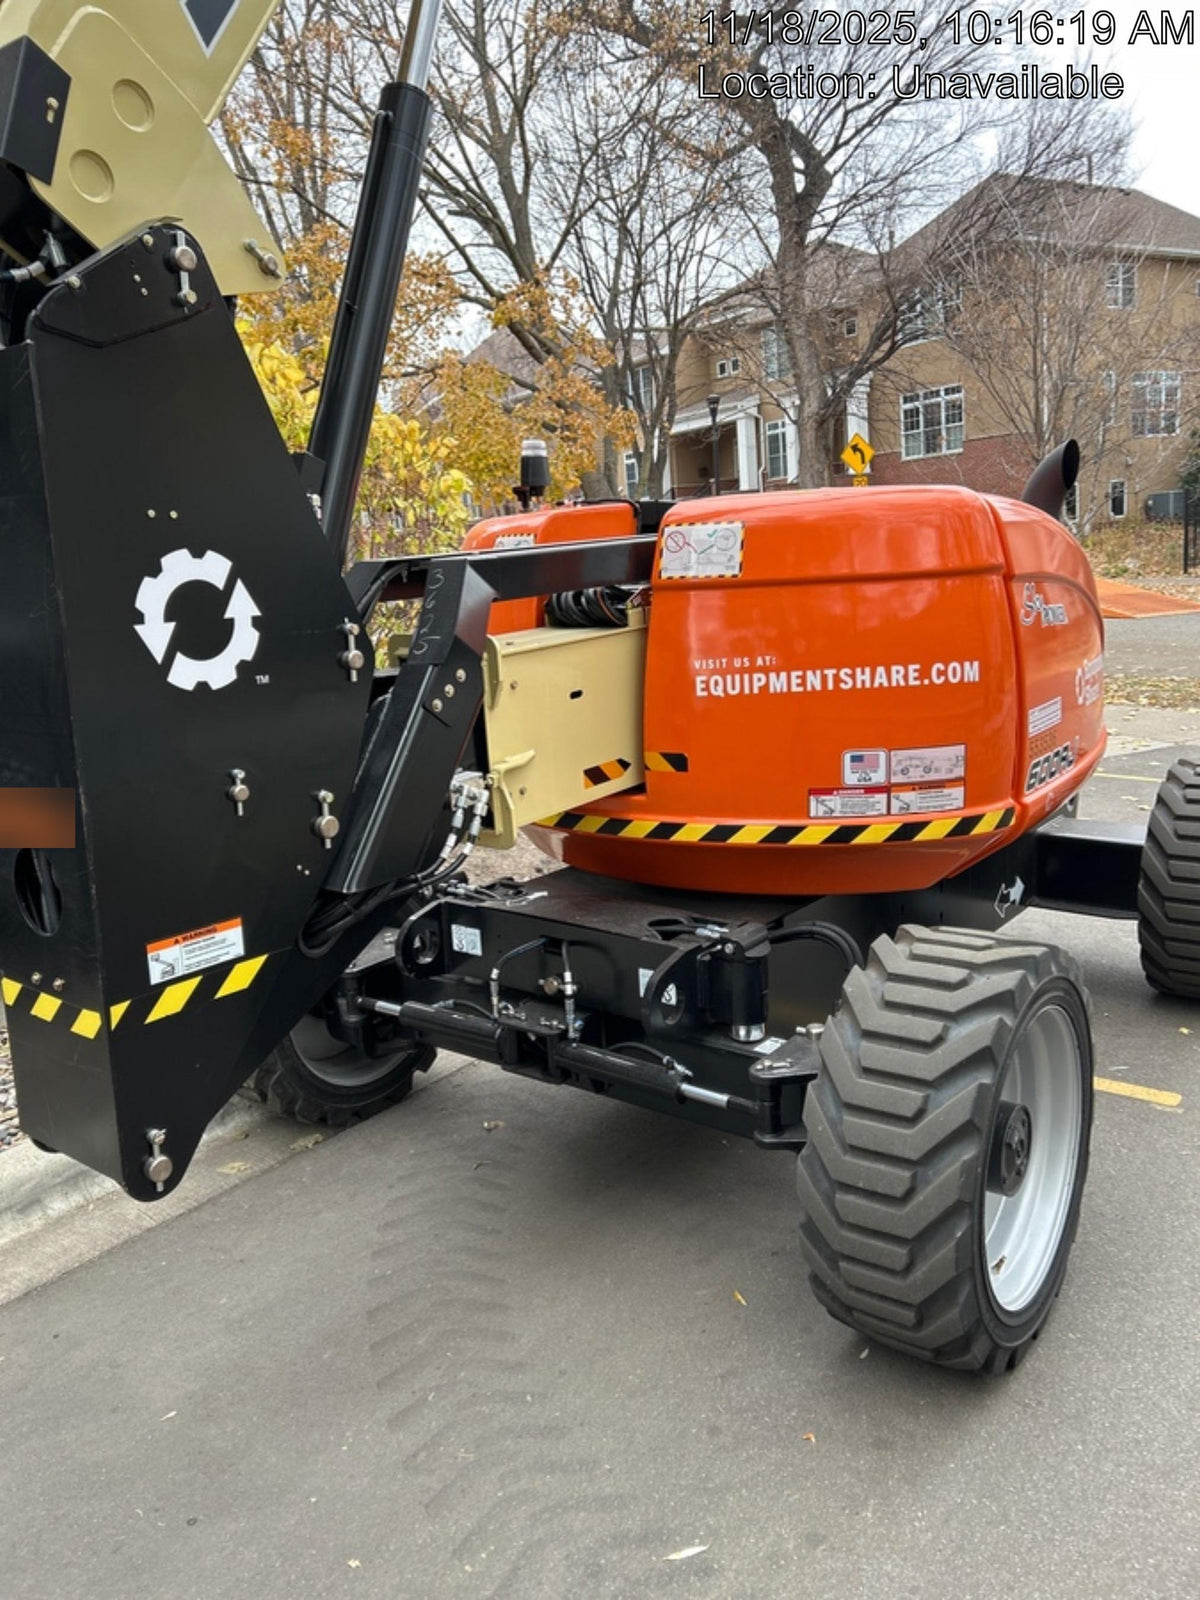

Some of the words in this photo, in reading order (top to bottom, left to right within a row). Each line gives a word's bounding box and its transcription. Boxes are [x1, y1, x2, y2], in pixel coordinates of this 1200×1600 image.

[694, 658, 728, 670] VISIT
[733, 656, 751, 668] US
[756, 655, 777, 667] AT:
[695, 660, 980, 697] EQUIPMENTSHARE.COM
